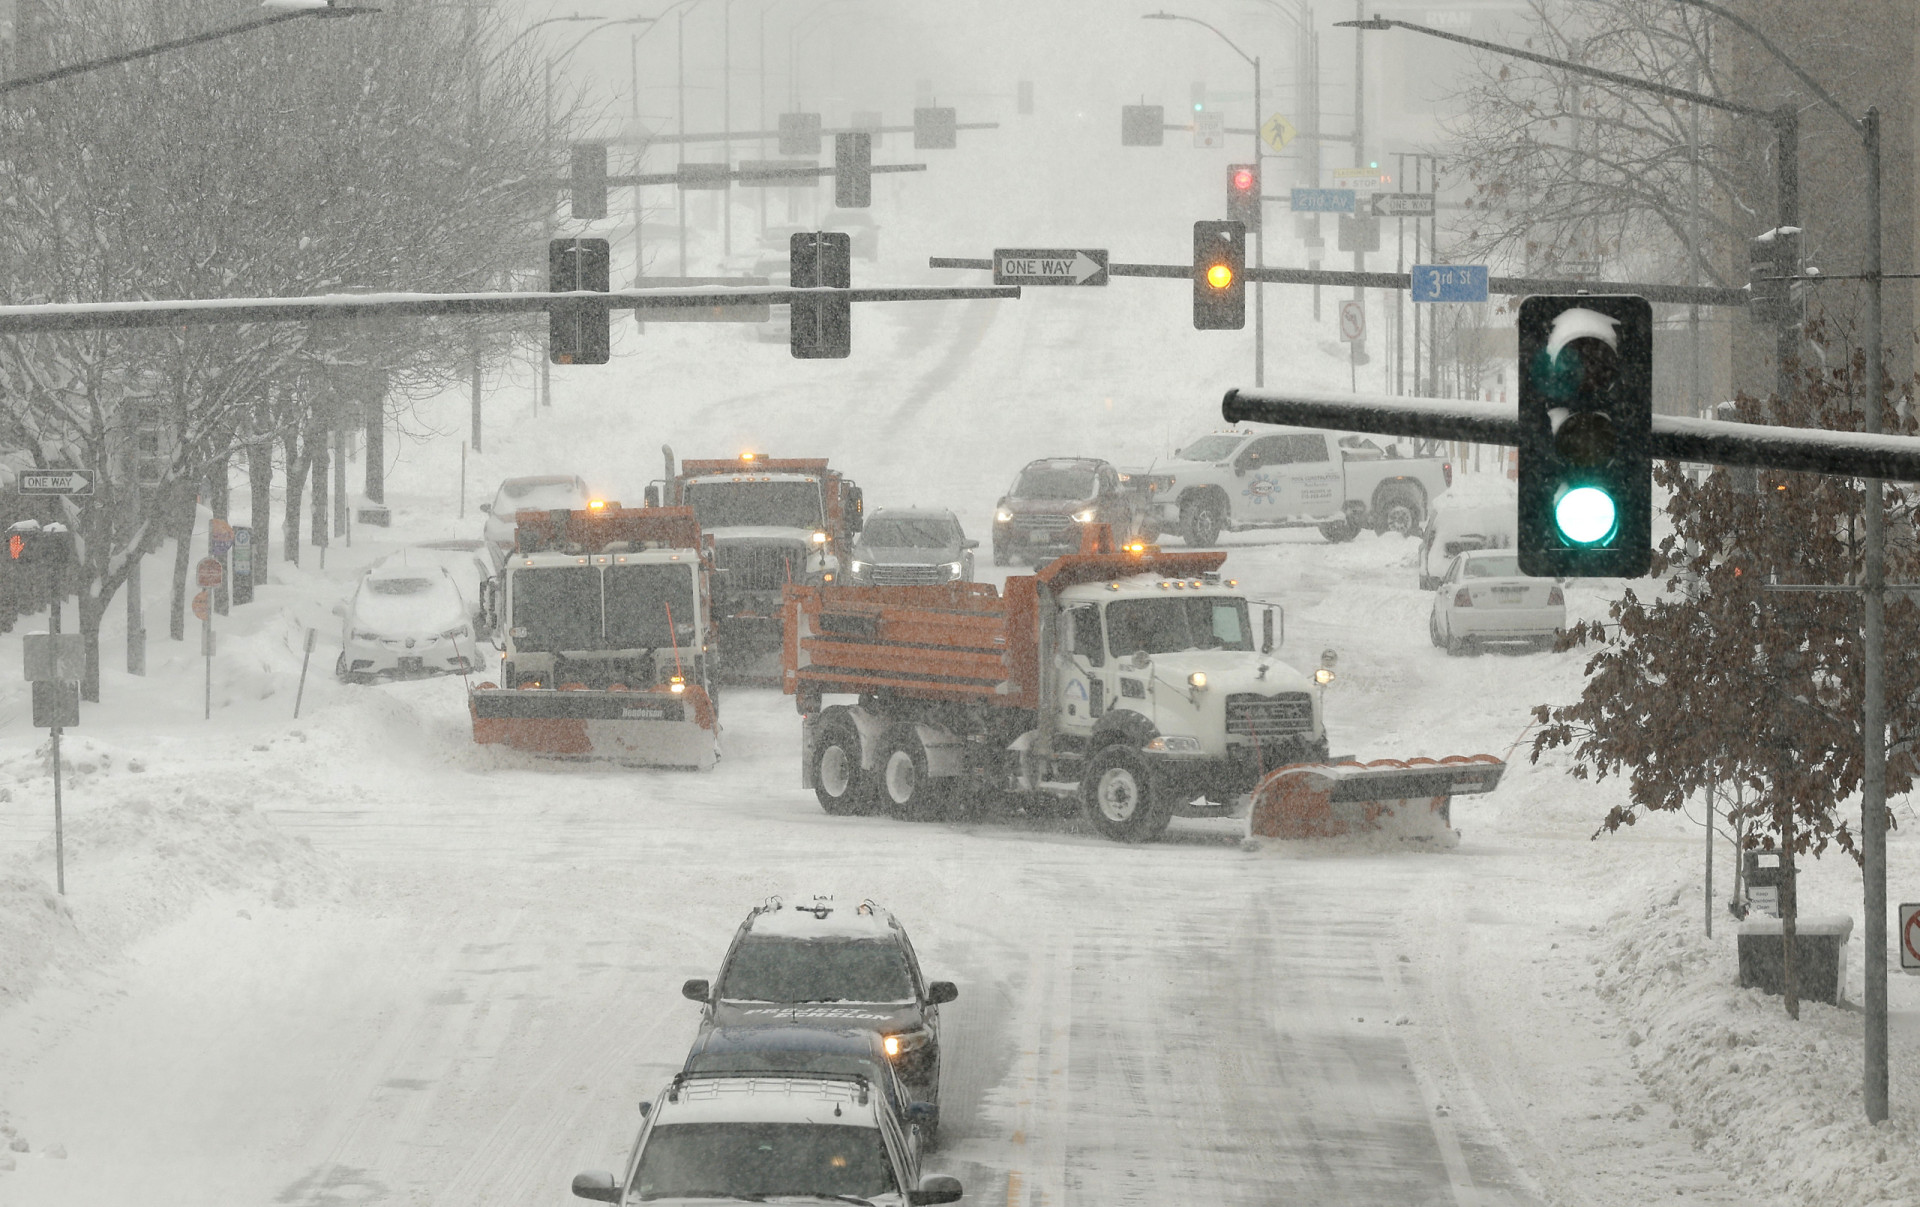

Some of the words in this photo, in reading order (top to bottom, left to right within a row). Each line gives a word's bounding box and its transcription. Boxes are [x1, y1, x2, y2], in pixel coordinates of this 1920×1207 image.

[1352, 179, 1377, 188] STOP
[1298, 193, 1326, 208] 2nd
[1331, 194, 1348, 208] Av
[1389, 200, 1407, 210] ONE
[1412, 200, 1429, 210] WAY
[1005, 260, 1037, 275] ONE
[1041, 260, 1074, 275] WAY
[1428, 269, 1453, 298] 3rd
[1459, 270, 1471, 285] St
[27, 477, 48, 487] ONE
[51, 477, 72, 487] WAY
[622, 707, 664, 718] Henderson
[743, 1007, 868, 1016] PROJECT
[773, 1011, 894, 1021] ECHELON
